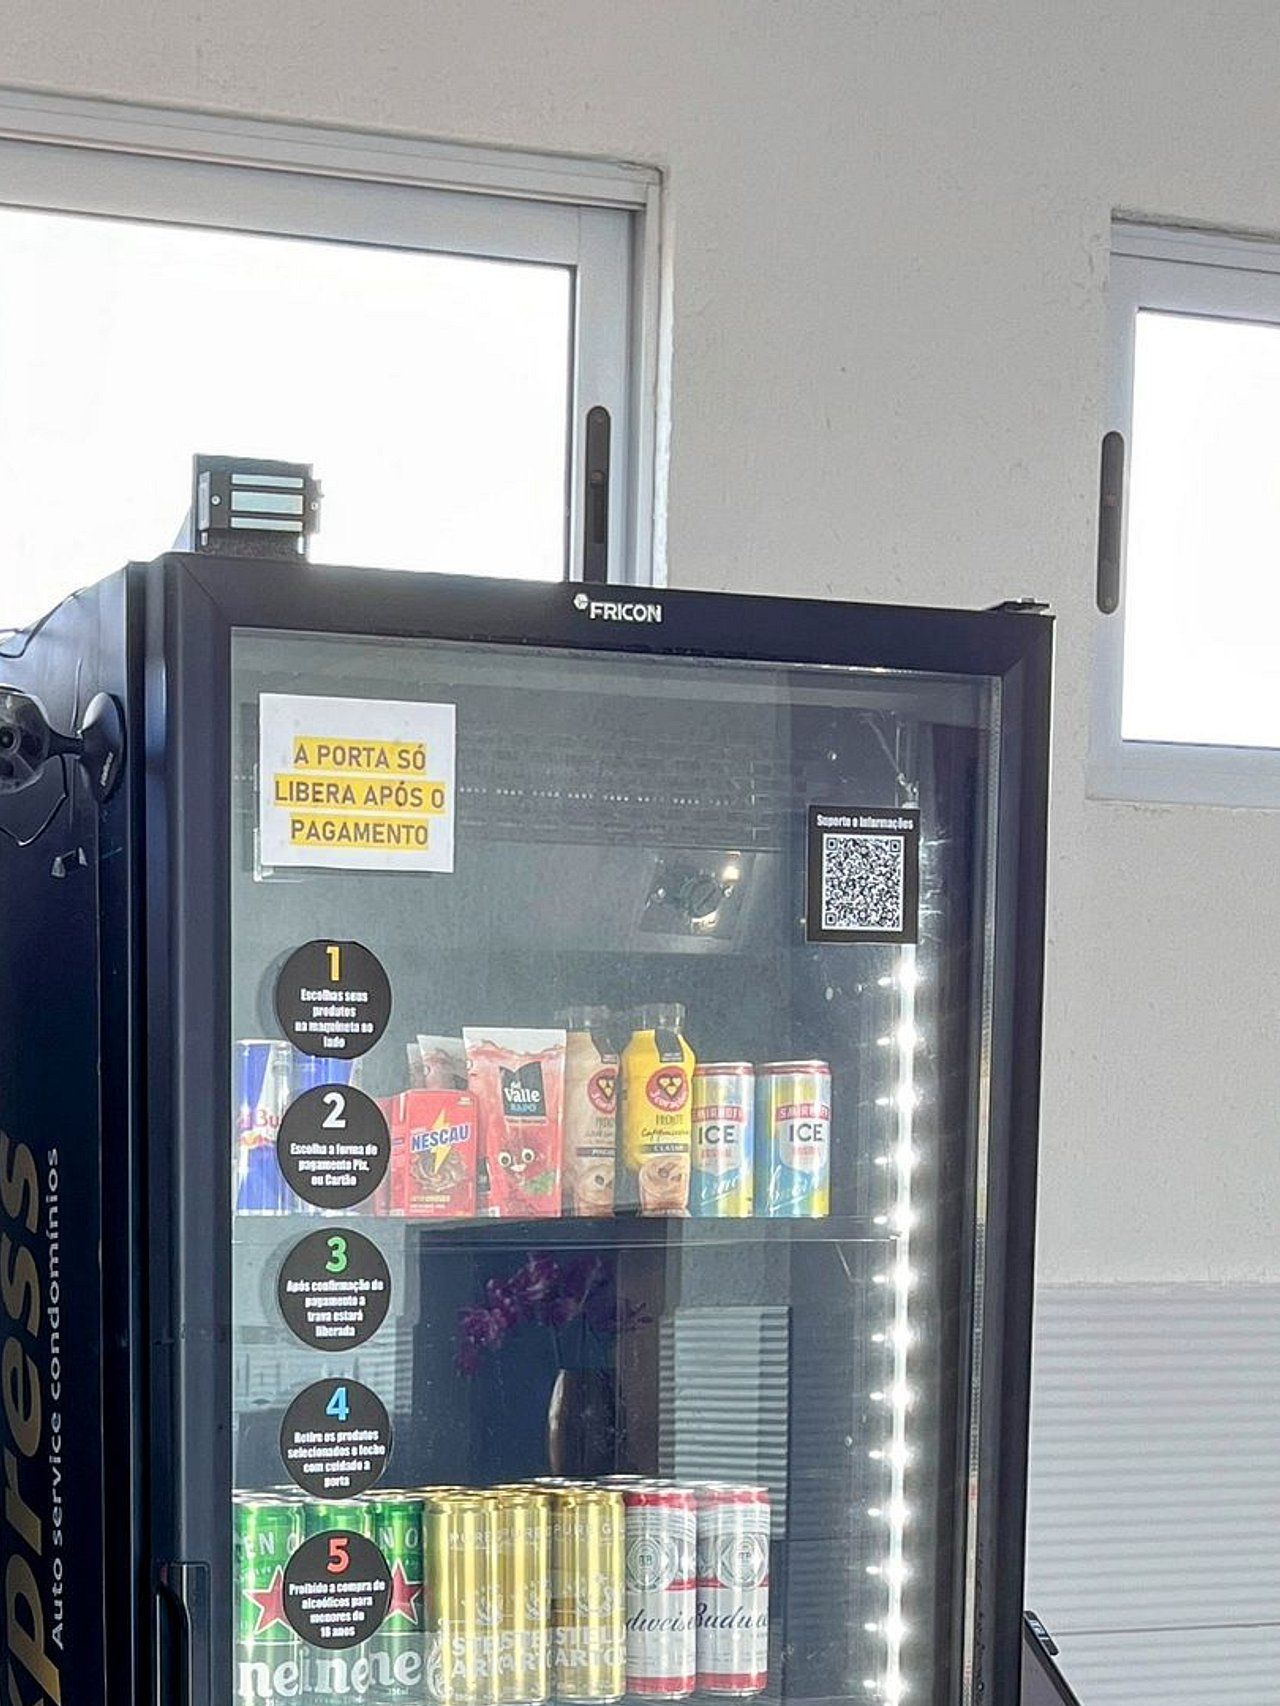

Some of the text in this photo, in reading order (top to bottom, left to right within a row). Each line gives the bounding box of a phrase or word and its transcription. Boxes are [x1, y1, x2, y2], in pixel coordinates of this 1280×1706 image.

[589, 601, 663, 623] FRICON
[293, 743, 427, 771] A PORTA SÓ
[274, 780, 445, 809] LIBERA APÓS O
[290, 818, 429, 846] PAGAMENTO
[325, 945, 340, 982] 1
[312, 1004, 357, 1018] produtos
[503, 1086, 541, 1104] Valle
[255, 1108, 280, 1129] Bu
[322, 1091, 347, 1129] 2
[410, 1123, 471, 1153] NESCAU
[698, 1124, 736, 1145] ICE
[788, 1122, 824, 1142] ICE
[290, 1142, 327, 1155] Escolha
[336, 1142, 364, 1155] forma
[298, 1159, 352, 1172] pagamento
[325, 1173, 357, 1187] Cartão
[325, 1235, 348, 1273] 3
[286, 1279, 310, 1293] Após
[311, 1278, 371, 1293] confirmação
[305, 1295, 358, 1309] pagamento
[44, 1147, 65, 1651] Auto service condomínios
[325, 1386, 350, 1421] 4
[293, 1430, 323, 1444] Retire
[336, 1429, 380, 1443] produtos
[287, 1445, 350, 1459] selecionados
[323, 1475, 350, 1488] porta
[326, 1537, 350, 1574] 5
[288, 1582, 328, 1596] Proibido
[336, 1581, 372, 1594] compra
